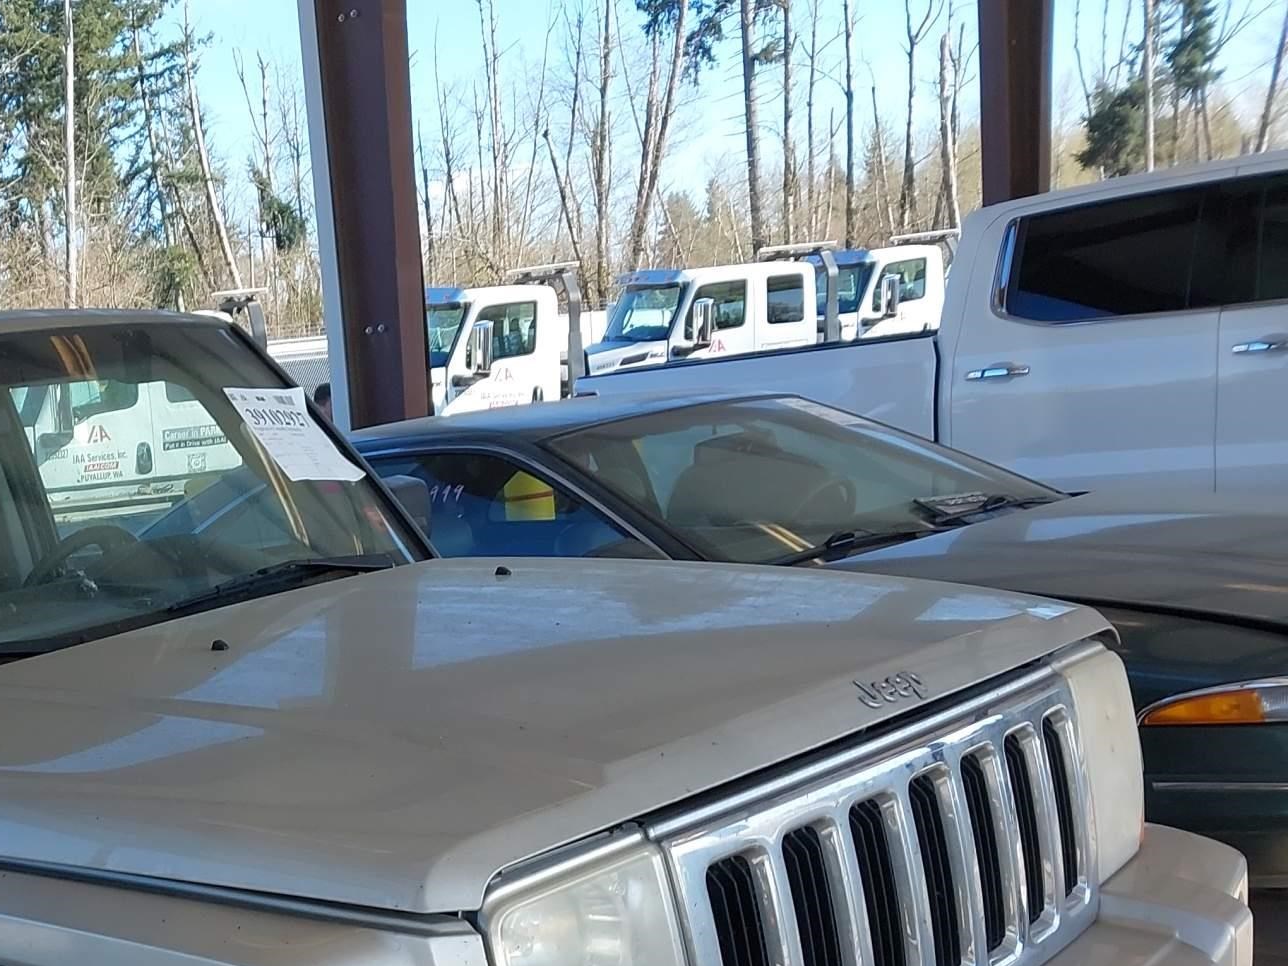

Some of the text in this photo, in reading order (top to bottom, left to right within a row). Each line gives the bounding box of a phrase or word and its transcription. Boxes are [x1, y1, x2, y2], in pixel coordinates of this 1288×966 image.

[245, 408, 310, 428] 39102927
[73, 453, 85, 464] IAA
[87, 452, 116, 463] Services,
[113, 470, 123, 478] WA
[852, 671, 926, 709] Jeep
